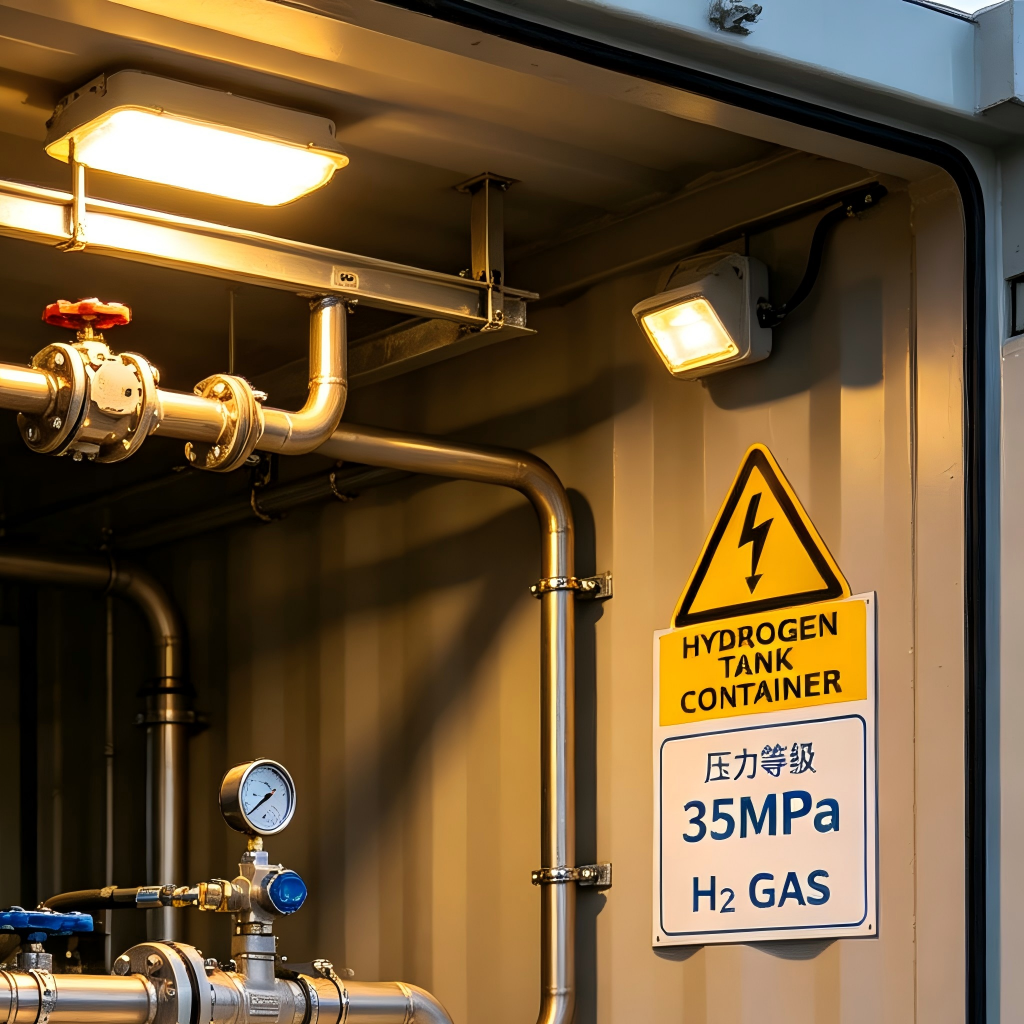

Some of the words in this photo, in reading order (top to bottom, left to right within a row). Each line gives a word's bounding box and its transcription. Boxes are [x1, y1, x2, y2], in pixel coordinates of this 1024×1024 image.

[682, 611, 838, 659] HYDROGEN
[718, 647, 794, 678] TANK
[680, 669, 842, 713] CONTAINER
[704, 743, 816, 784] 压力等级
[682, 790, 840, 843] 35MPa
[748, 869, 831, 909] GAS
